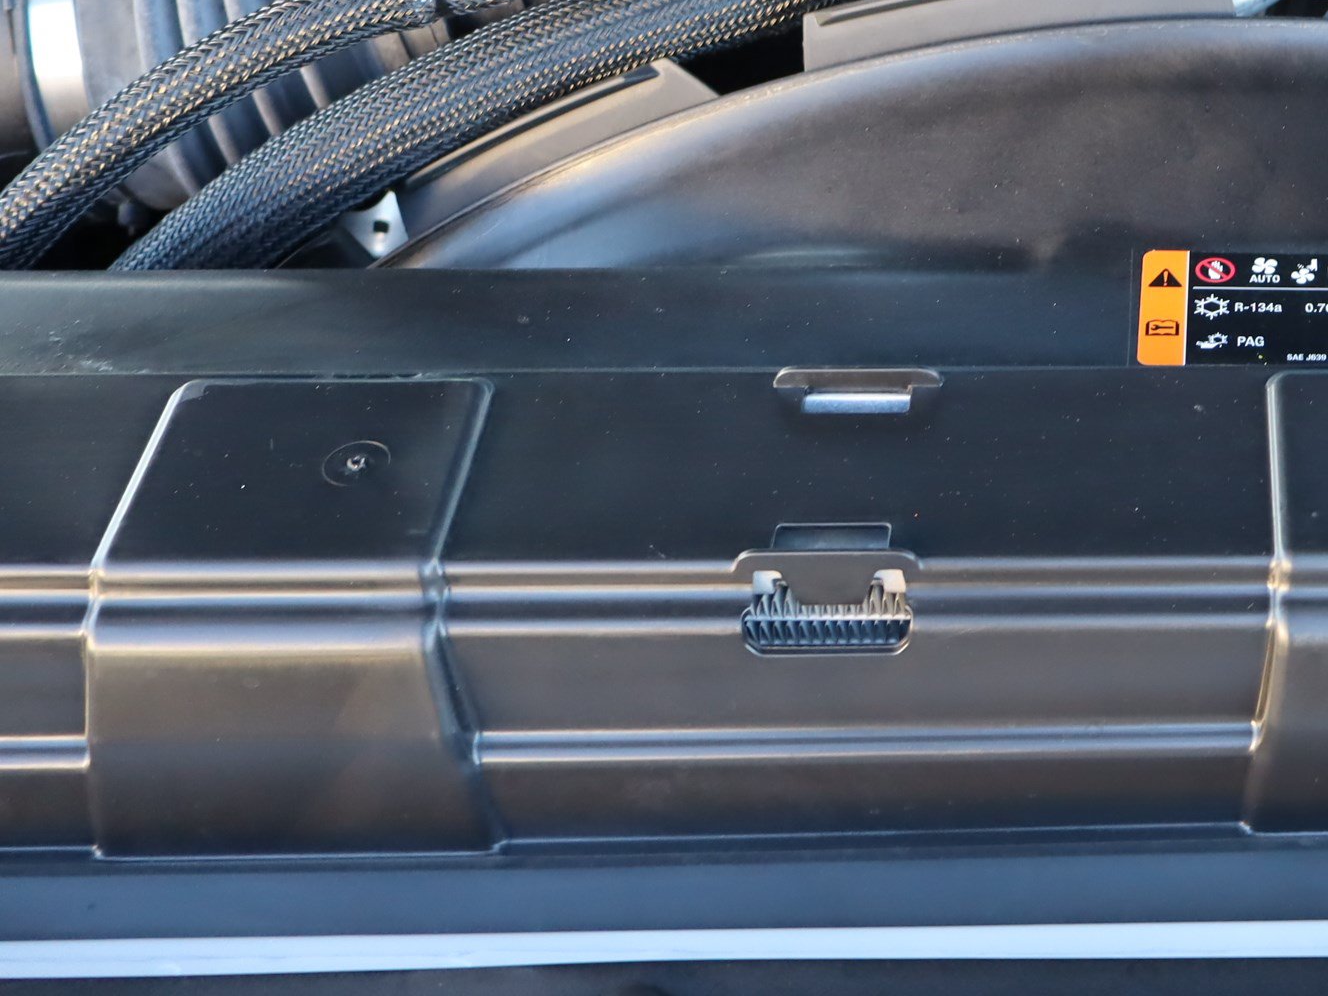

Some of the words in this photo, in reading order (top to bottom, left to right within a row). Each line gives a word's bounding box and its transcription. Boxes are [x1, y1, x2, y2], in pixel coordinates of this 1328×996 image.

[1249, 275, 1280, 284] AUTO
[1234, 302, 1282, 313] R-134a
[1237, 335, 1265, 347] PAG
[1286, 353, 1304, 361] SAE
